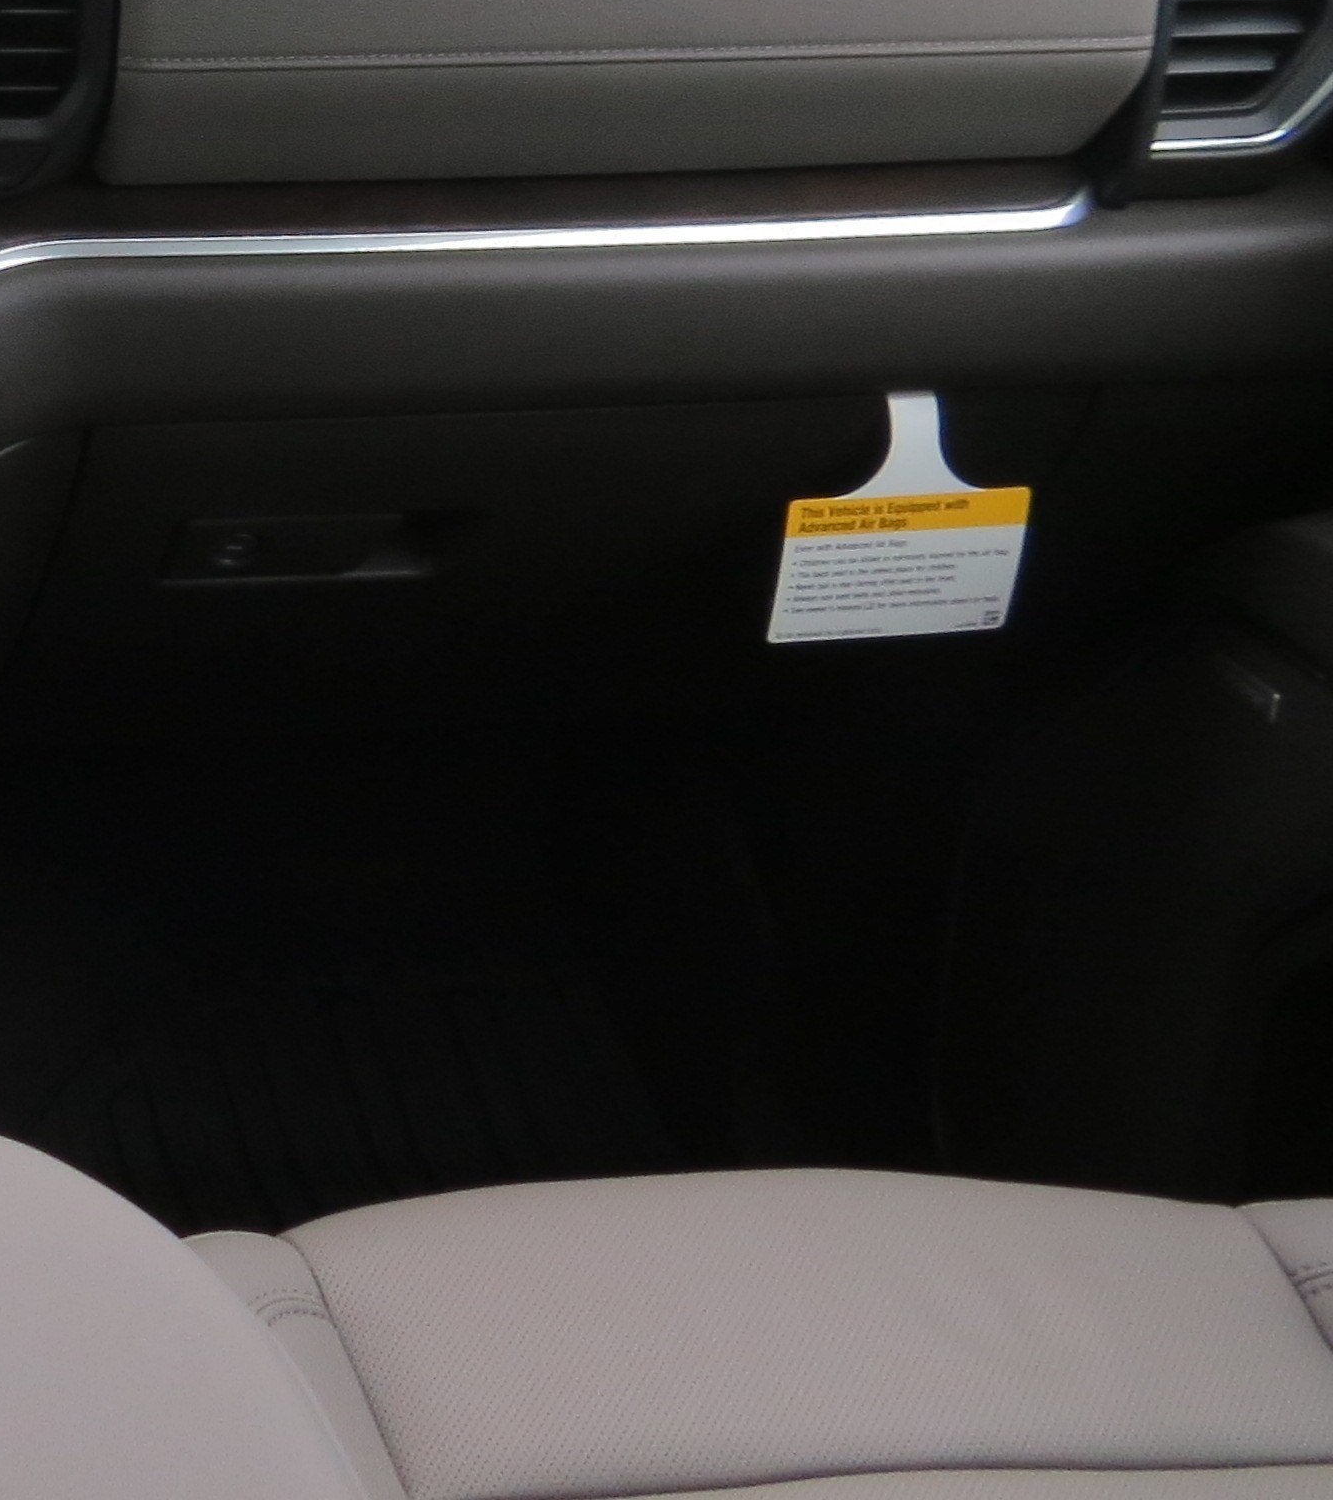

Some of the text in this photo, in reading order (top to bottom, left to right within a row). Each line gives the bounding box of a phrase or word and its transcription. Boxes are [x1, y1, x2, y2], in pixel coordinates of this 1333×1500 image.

[829, 505, 871, 517] Vehicle
[798, 518, 907, 534] Advanced Air Bags
